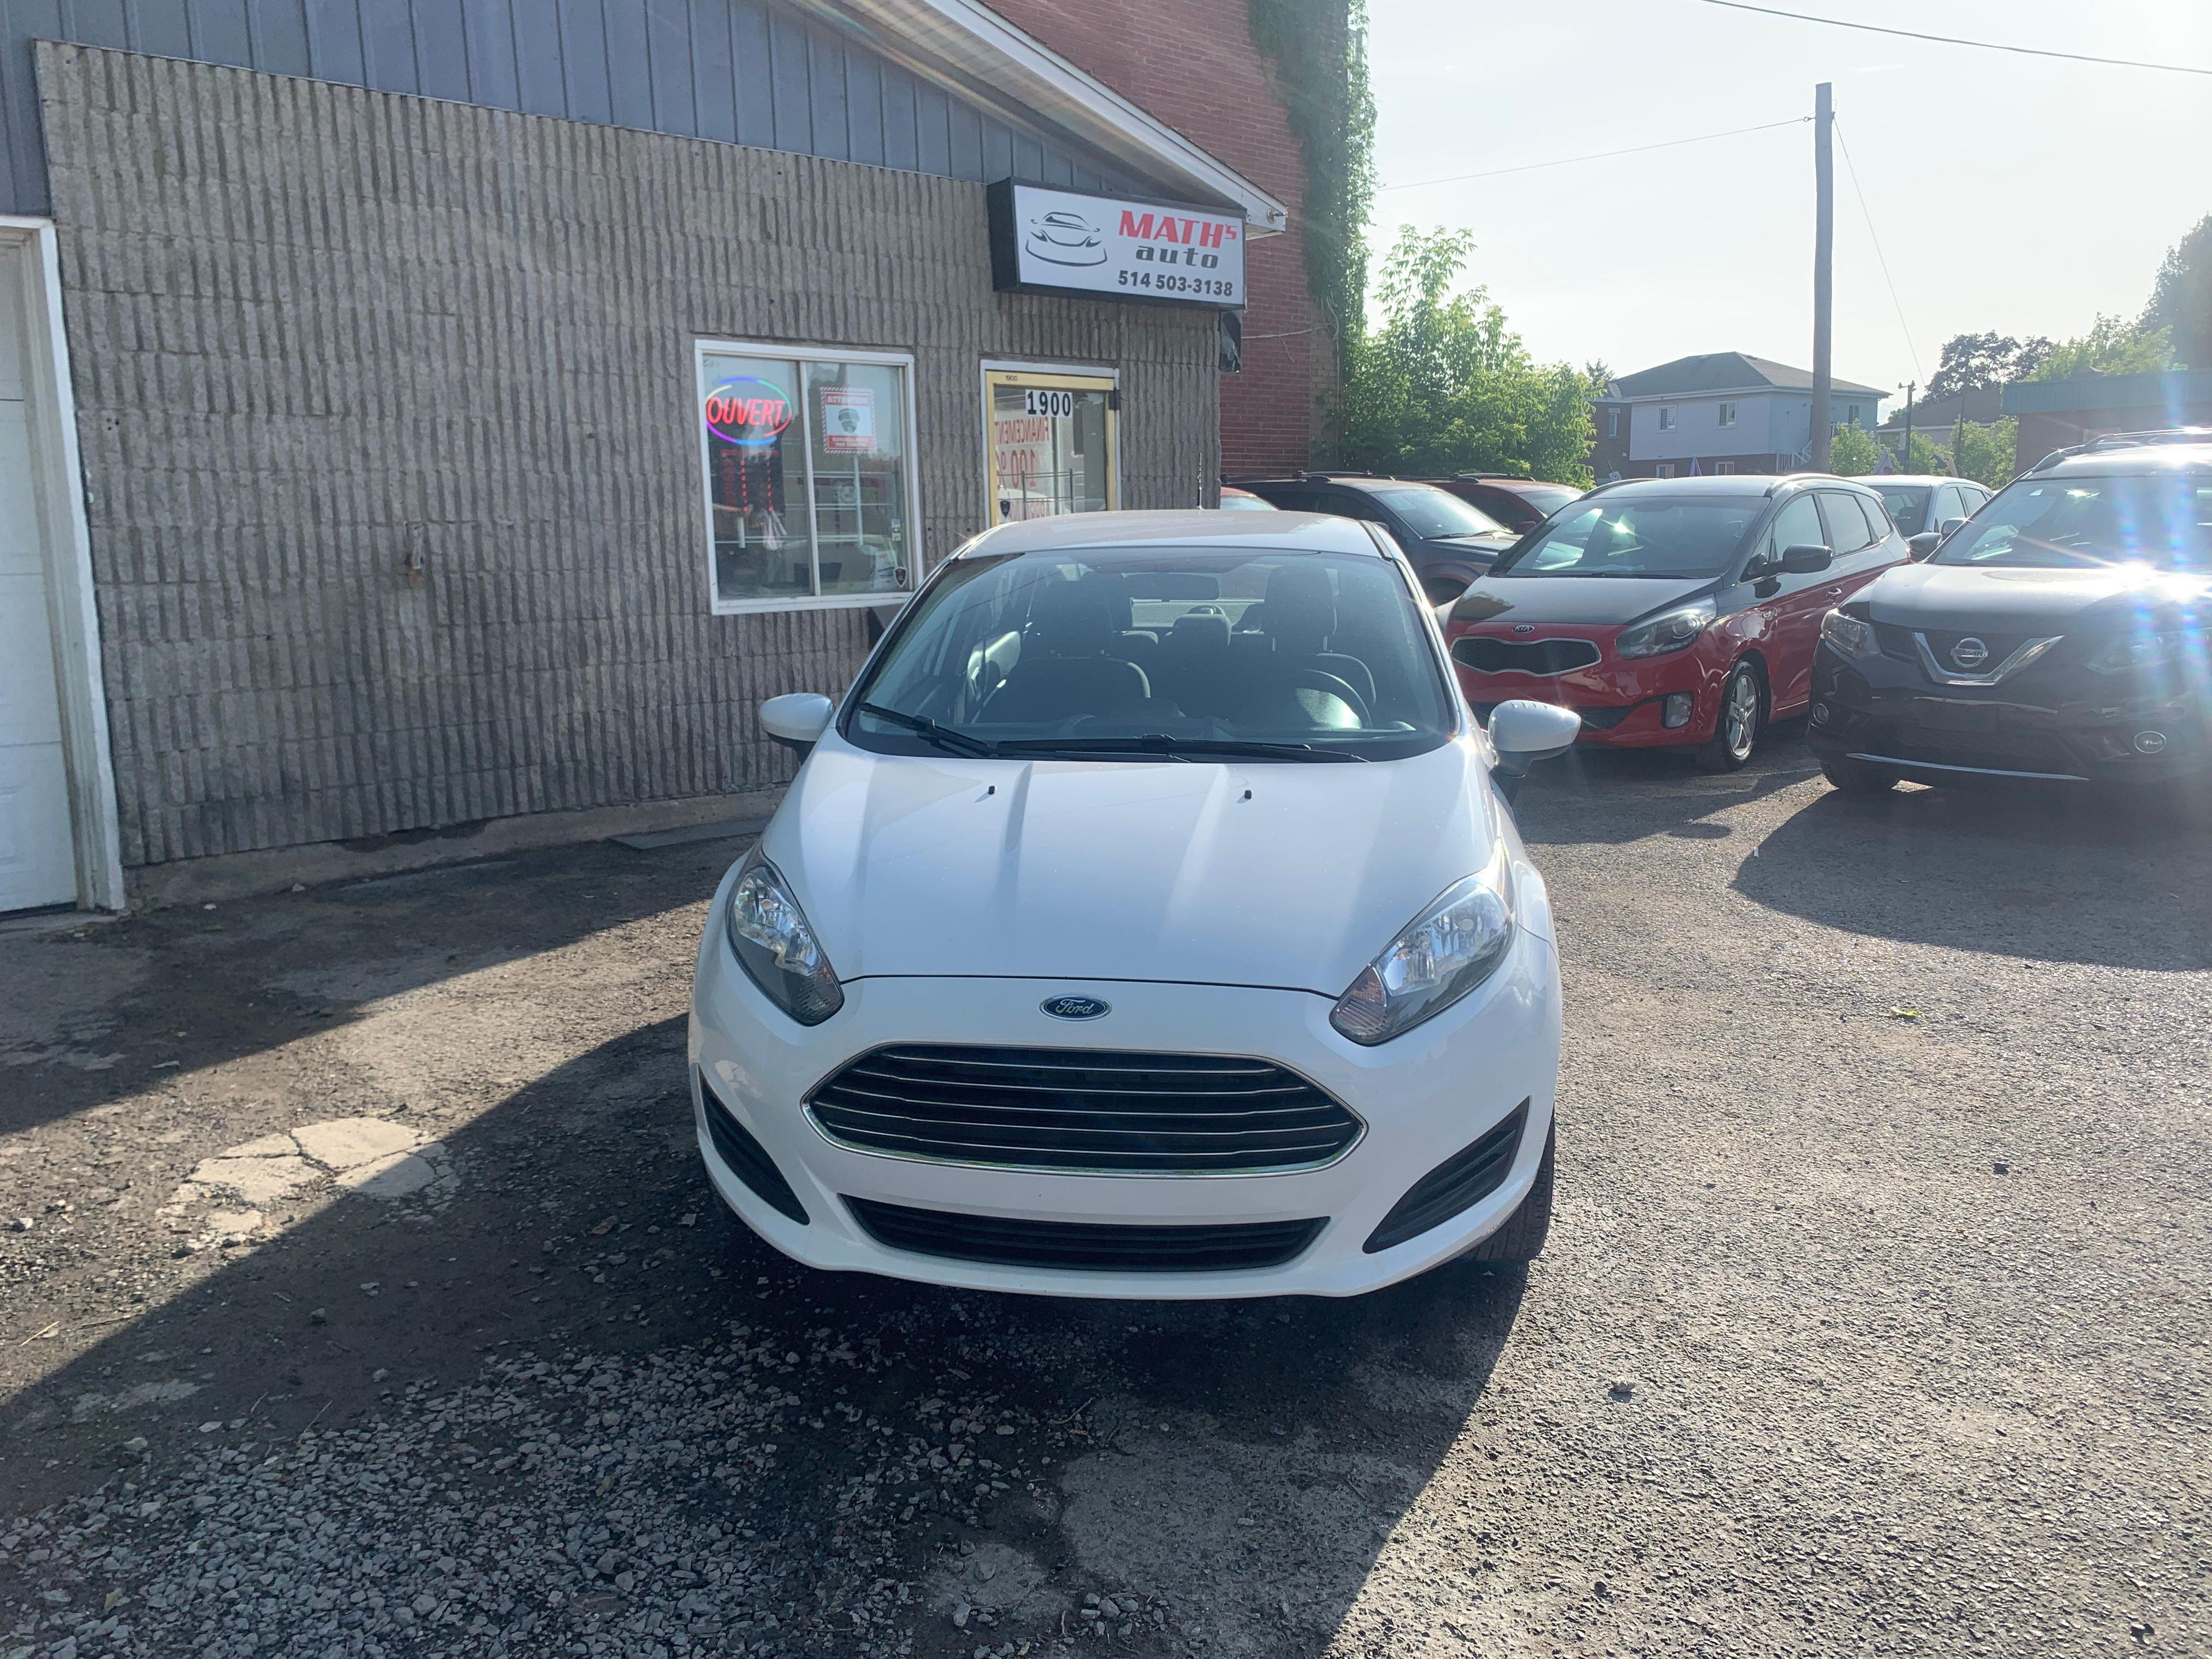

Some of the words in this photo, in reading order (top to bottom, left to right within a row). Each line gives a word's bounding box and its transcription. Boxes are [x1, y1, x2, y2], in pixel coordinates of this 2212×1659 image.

[1135, 245, 1219, 268] auto
[1118, 270, 1152, 289] 514
[1156, 275, 1233, 297] 503-3138
[706, 396, 785, 427] OUVERT
[1027, 391, 1071, 416] 1900
[1055, 998, 1094, 1014] Ford
